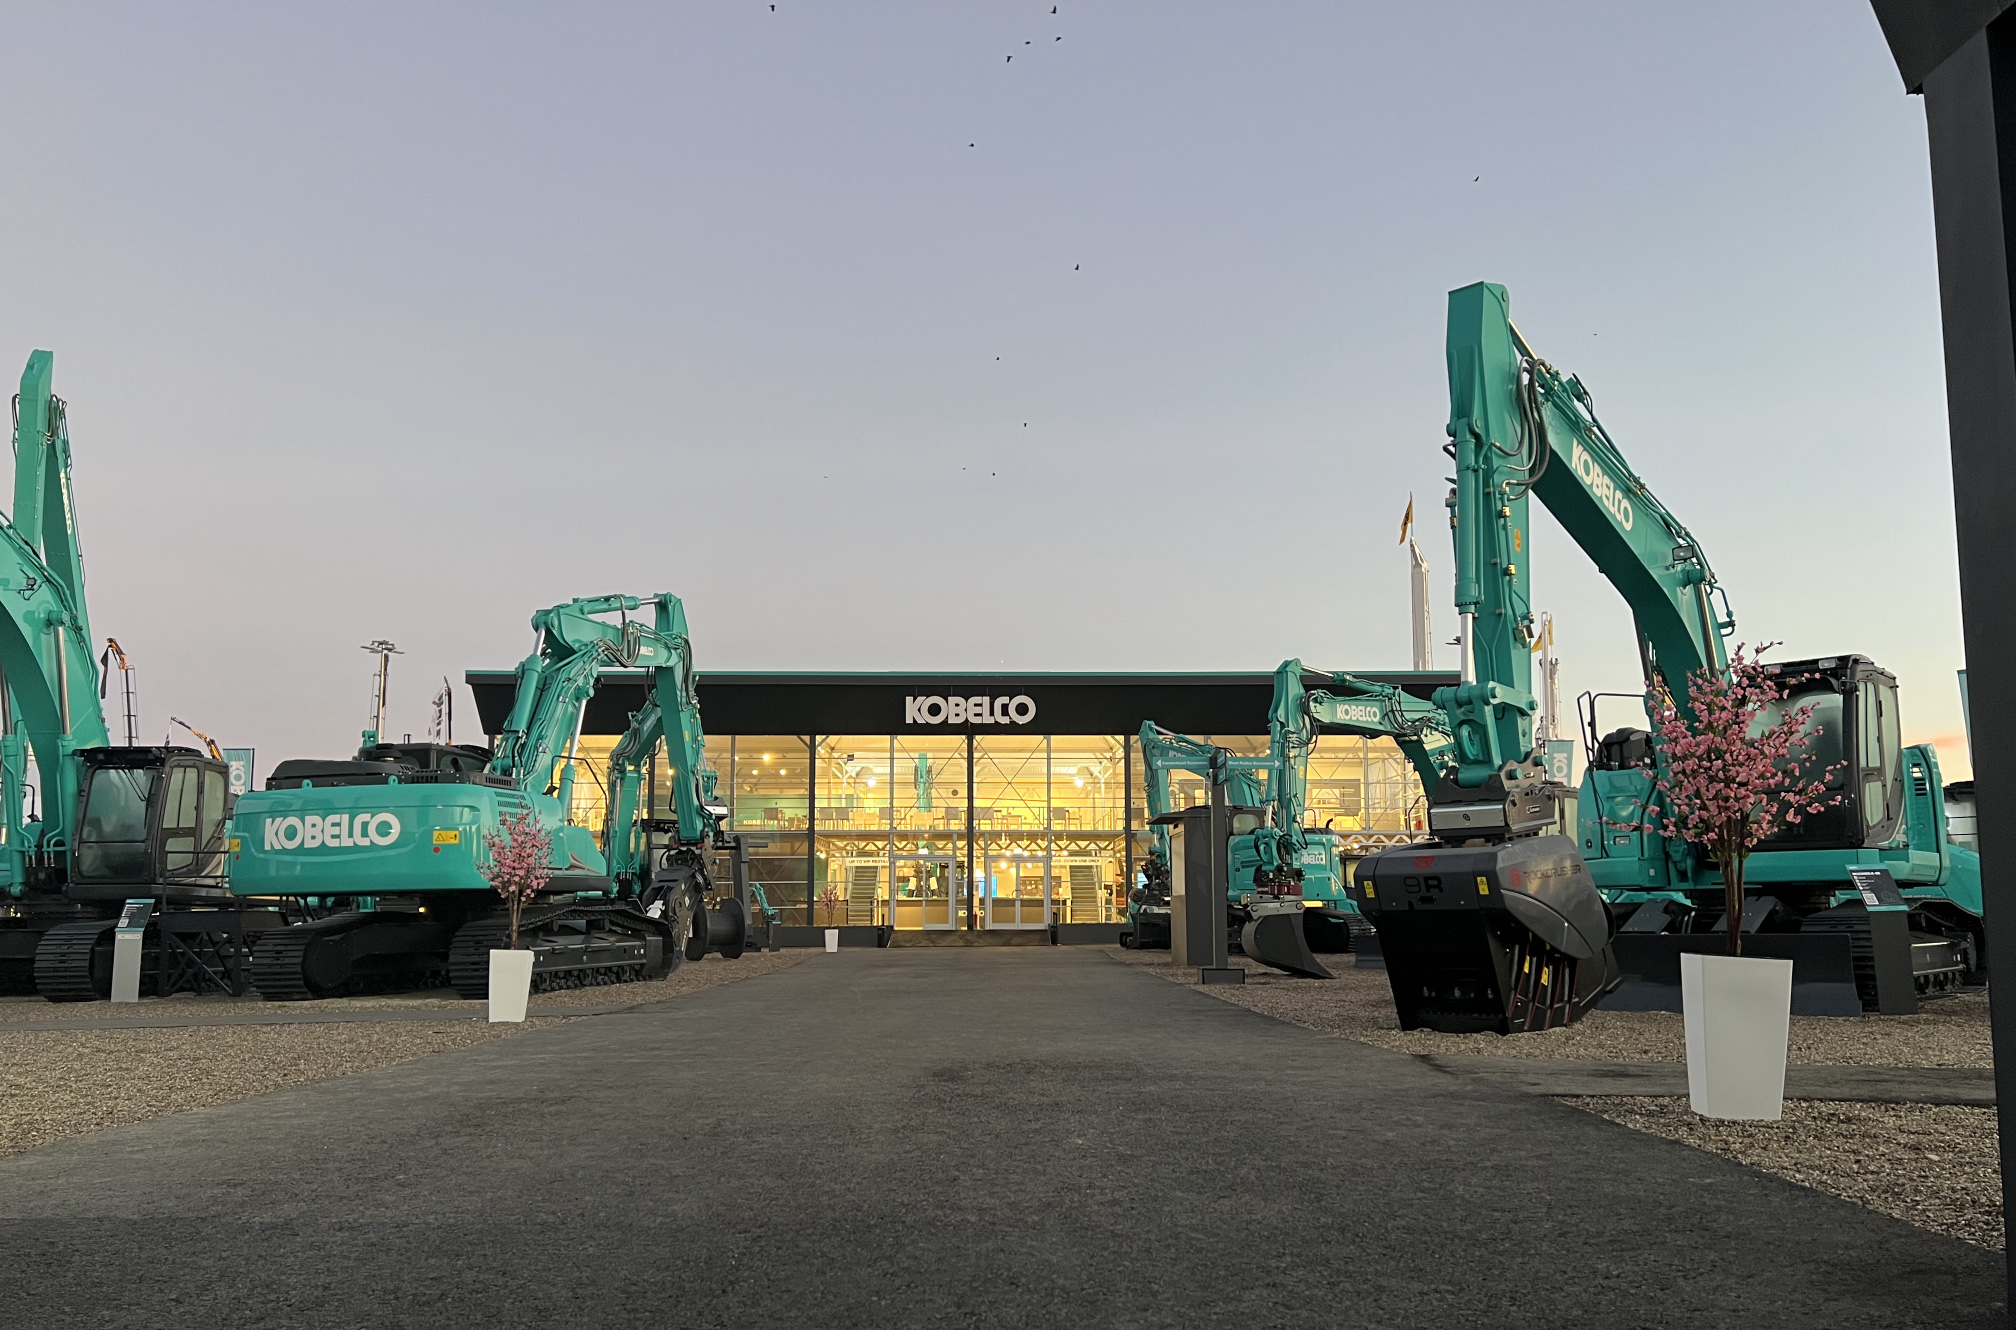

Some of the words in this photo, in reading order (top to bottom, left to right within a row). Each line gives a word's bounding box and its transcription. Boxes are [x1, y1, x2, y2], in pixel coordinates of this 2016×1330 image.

[1571, 437, 1634, 532] KOBELCO
[905, 695, 1037, 725] KOBELCO
[1336, 703, 1380, 722] KOBELCO
[264, 812, 401, 850] KOBELCO
[1403, 876, 1444, 893] 9R
